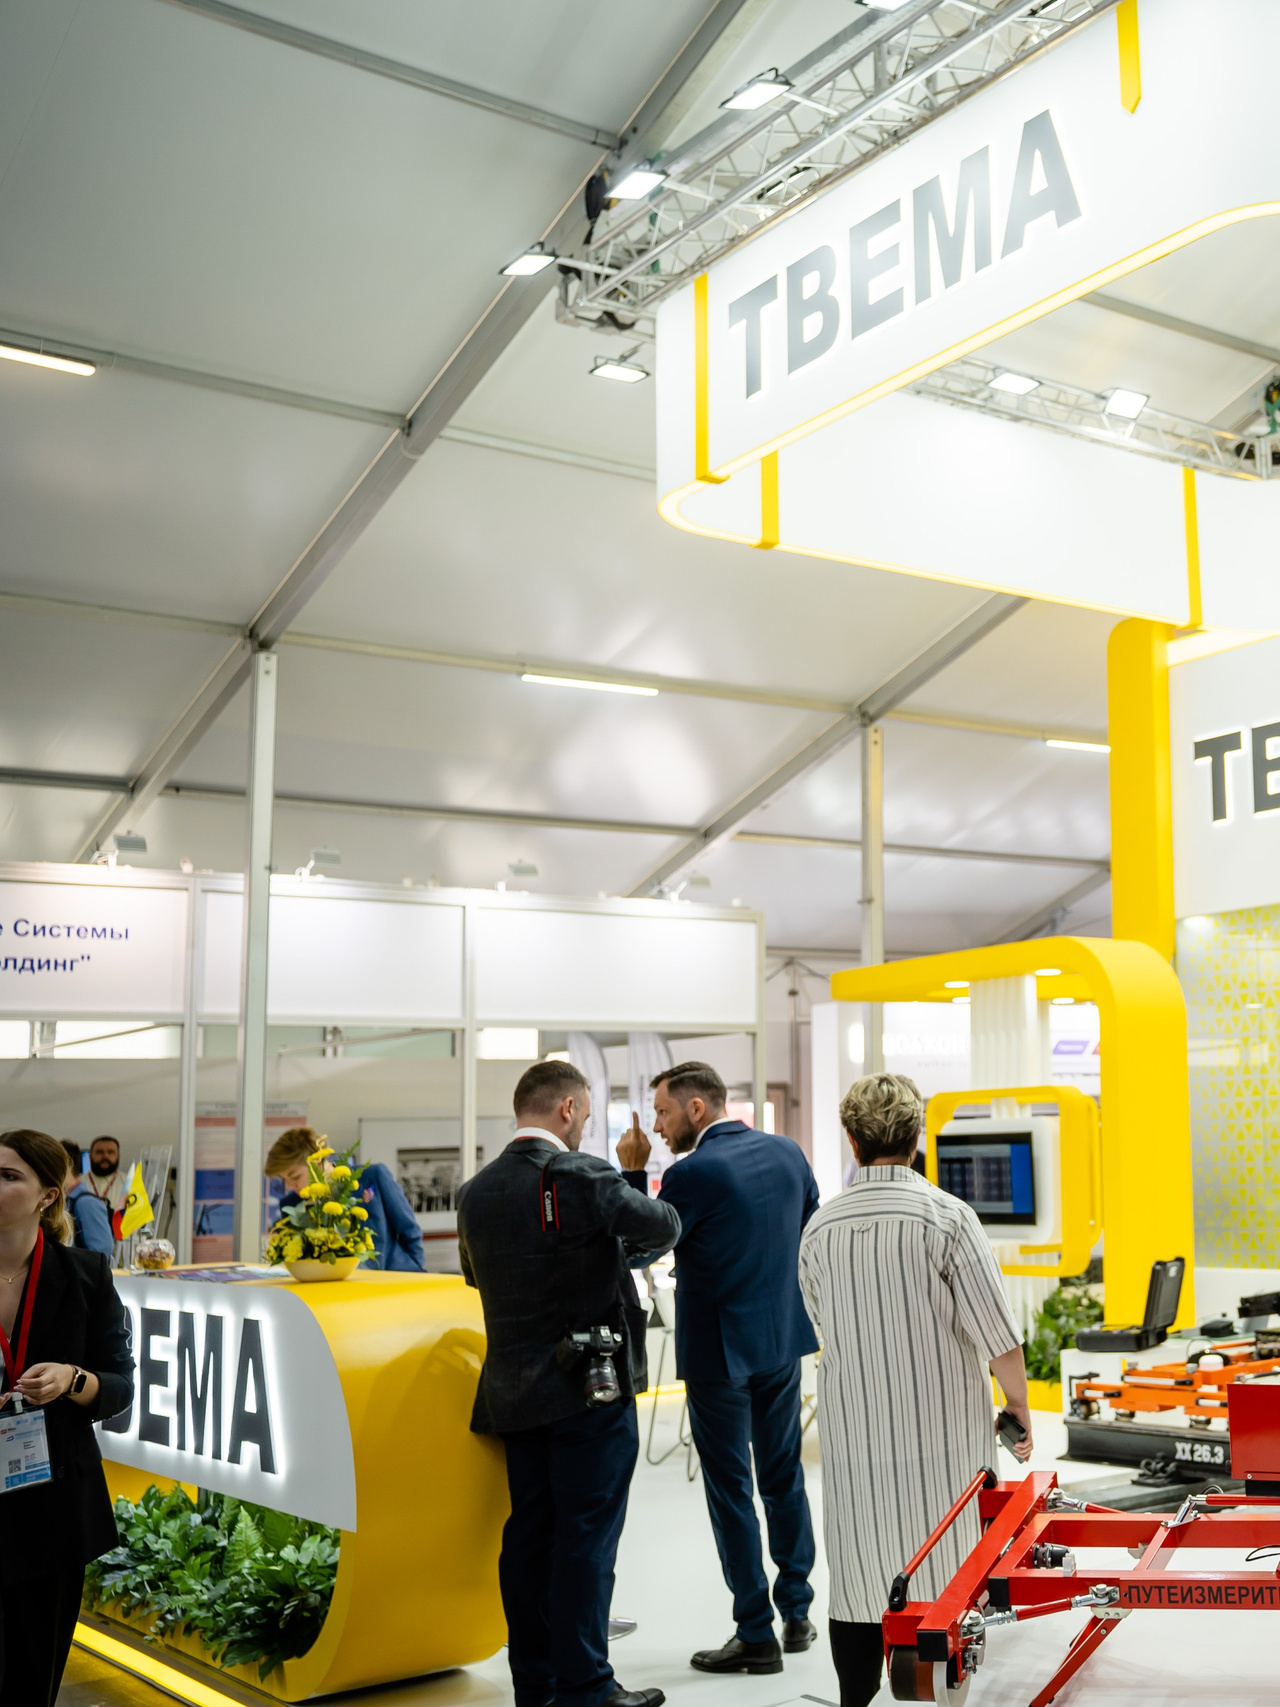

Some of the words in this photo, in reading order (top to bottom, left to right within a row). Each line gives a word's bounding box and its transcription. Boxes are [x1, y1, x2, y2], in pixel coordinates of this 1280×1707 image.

[729, 109, 1082, 399] ТВЕМА
[13, 918, 129, 940] Системы
[0, 954, 91, 974] лдинг"
[1193, 1444, 1224, 1464] 26.3
